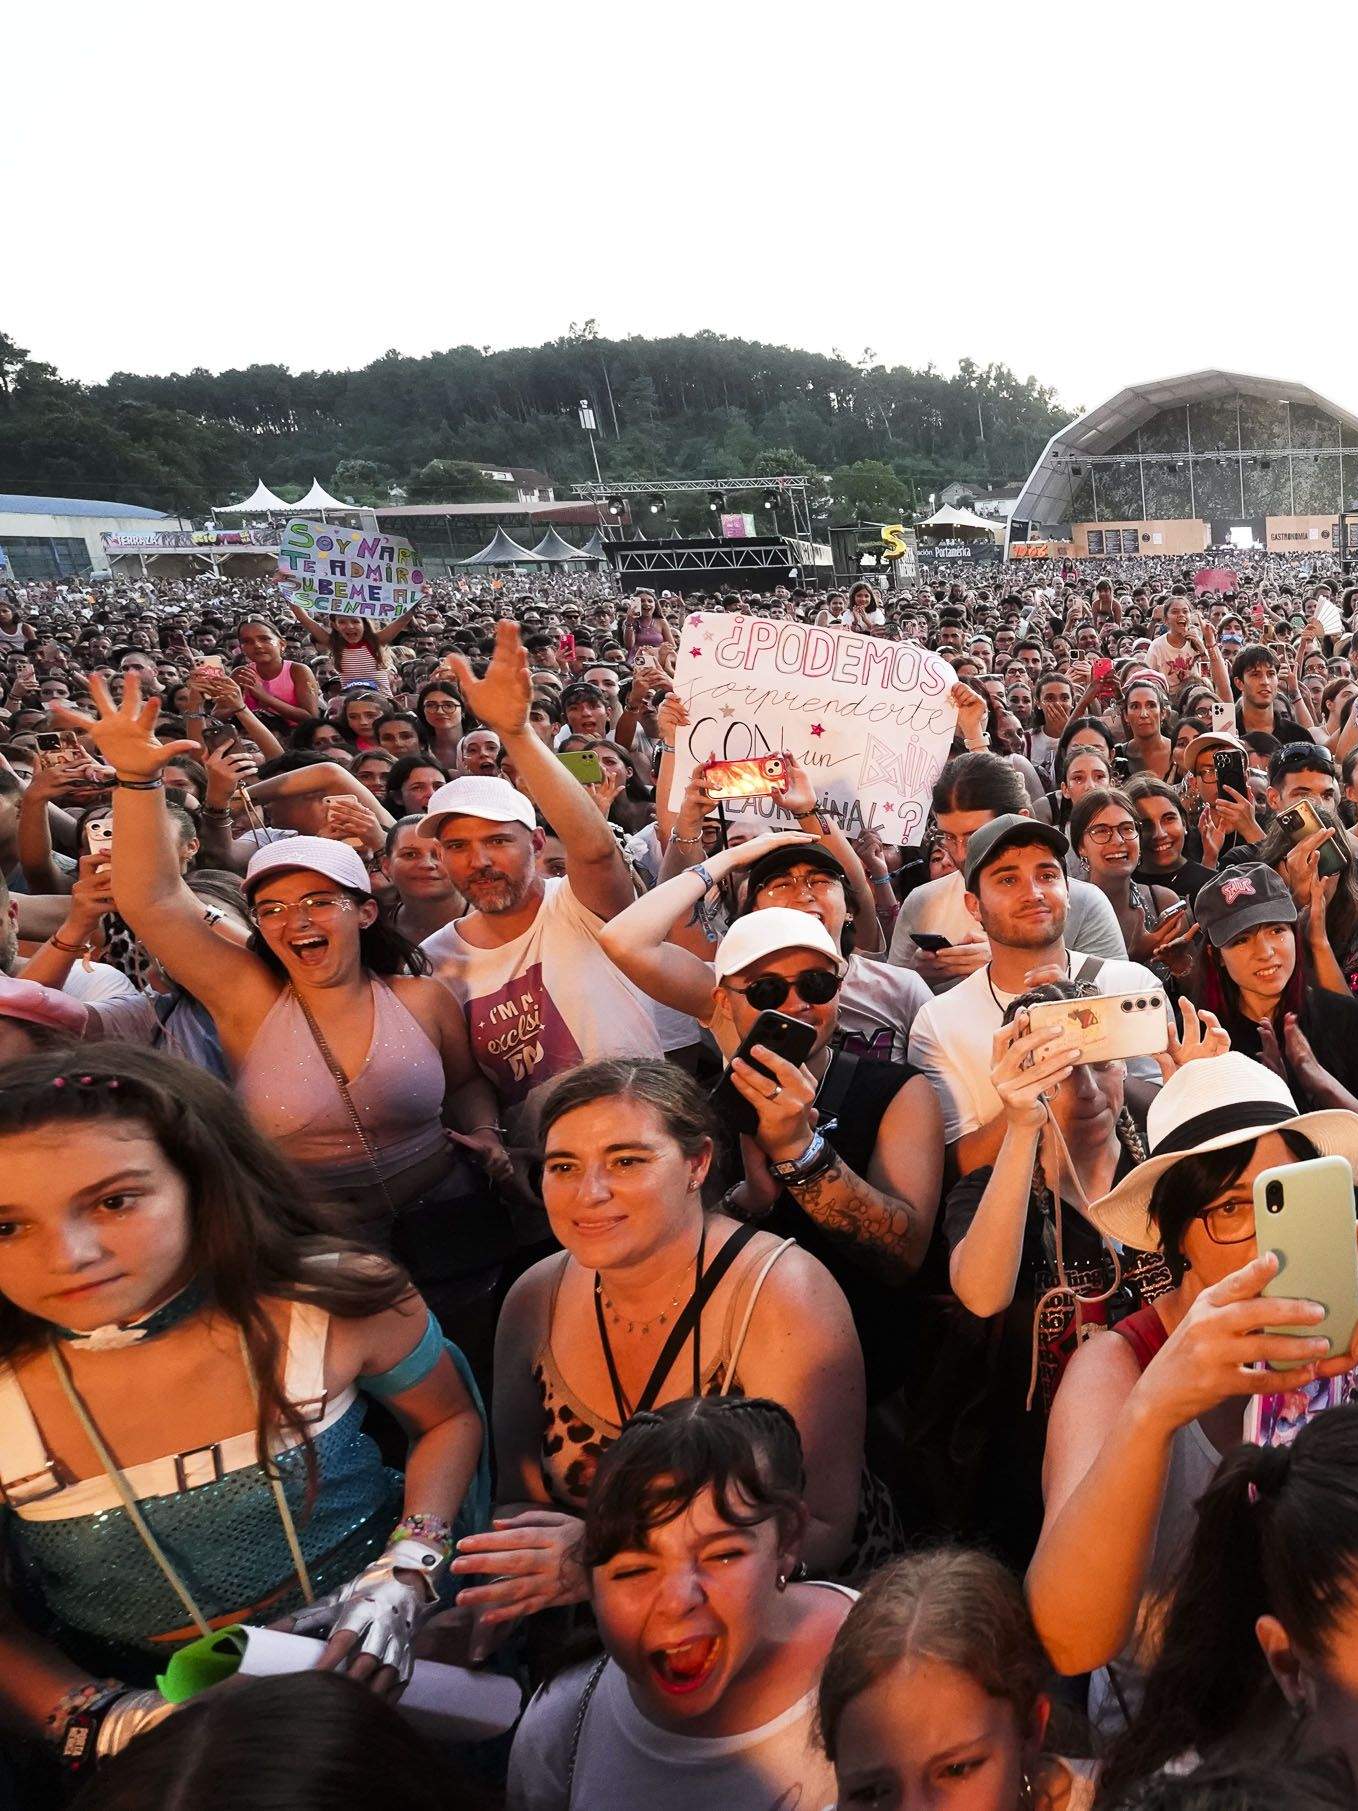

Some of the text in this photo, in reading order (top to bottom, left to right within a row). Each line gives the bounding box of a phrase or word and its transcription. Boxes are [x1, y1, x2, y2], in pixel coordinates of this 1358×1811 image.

[288, 523, 351, 554] SOY
[281, 550, 316, 573] TE
[280, 576, 420, 604] SUBEME AL
[715, 616, 946, 696] ¿PODEMOS
[688, 716, 784, 763] CON
[489, 1000, 519, 1024] I'M
